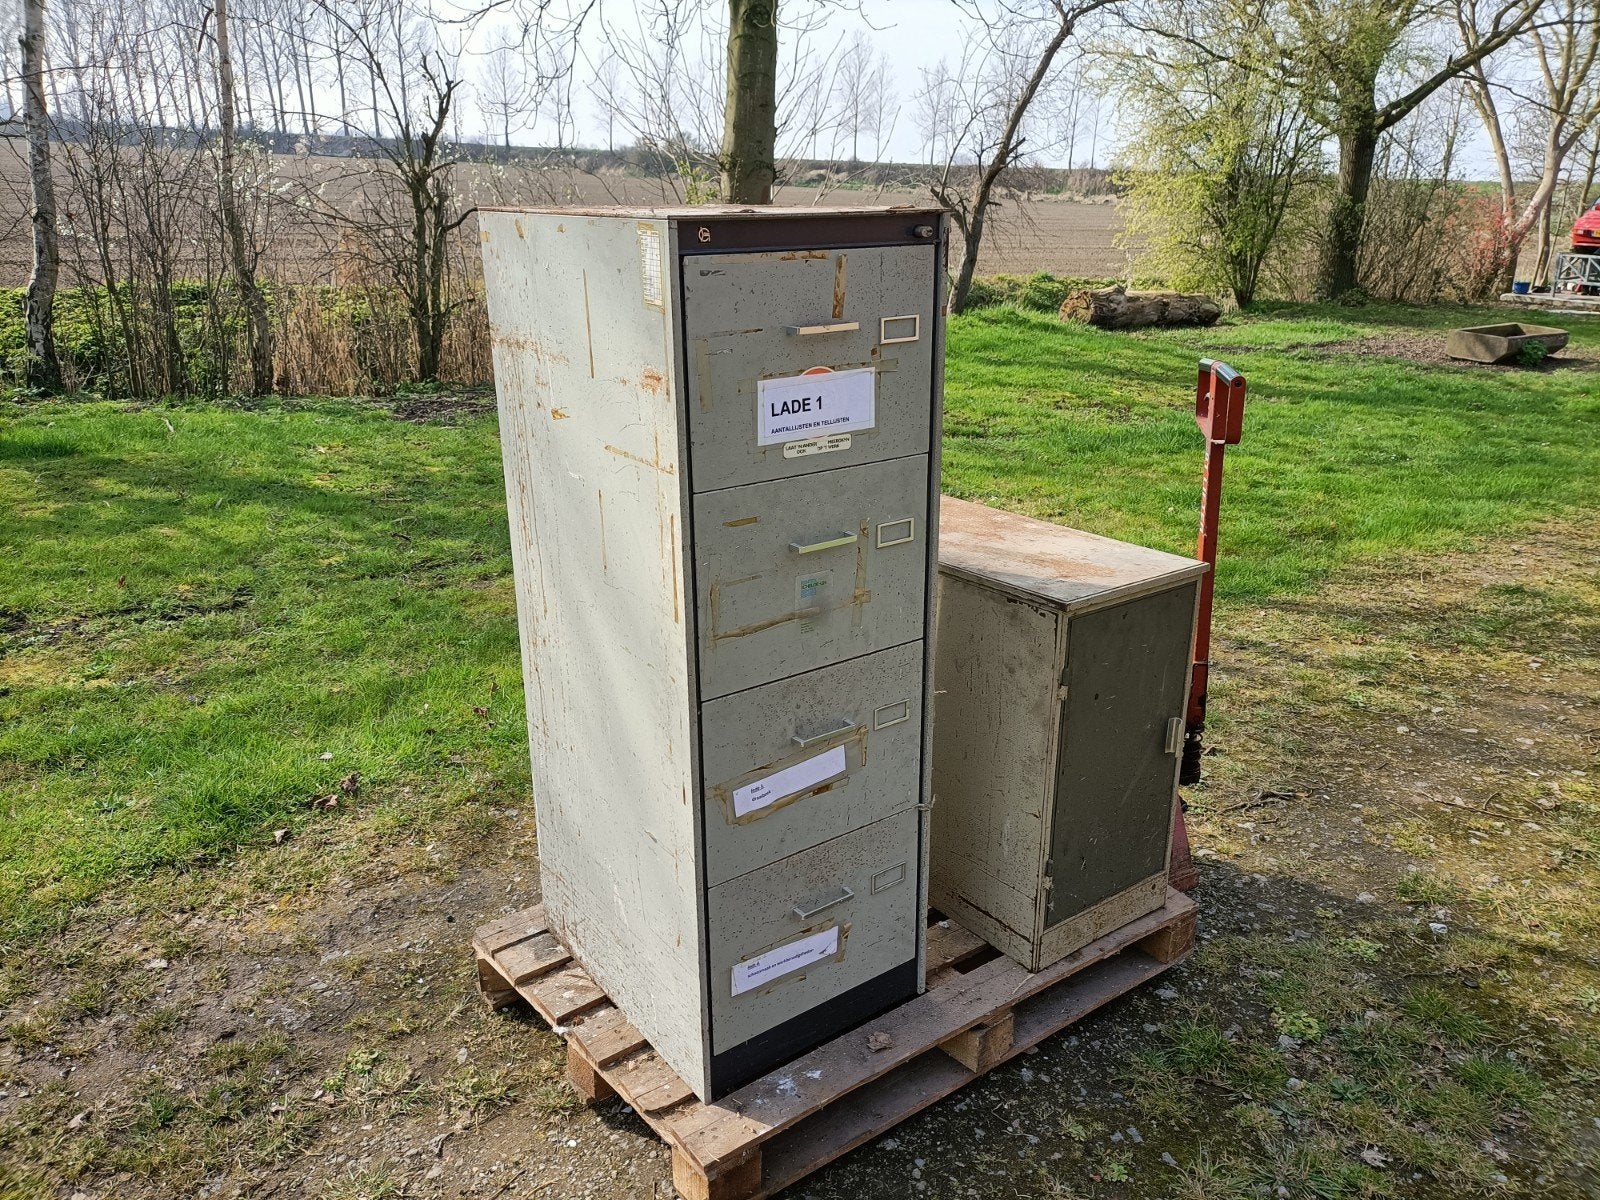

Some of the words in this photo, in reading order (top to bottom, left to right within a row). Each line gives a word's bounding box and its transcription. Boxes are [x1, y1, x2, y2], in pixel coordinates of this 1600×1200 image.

[771, 397, 811, 417] LADE
[815, 395, 823, 410] 1
[813, 420, 821, 428] EN
